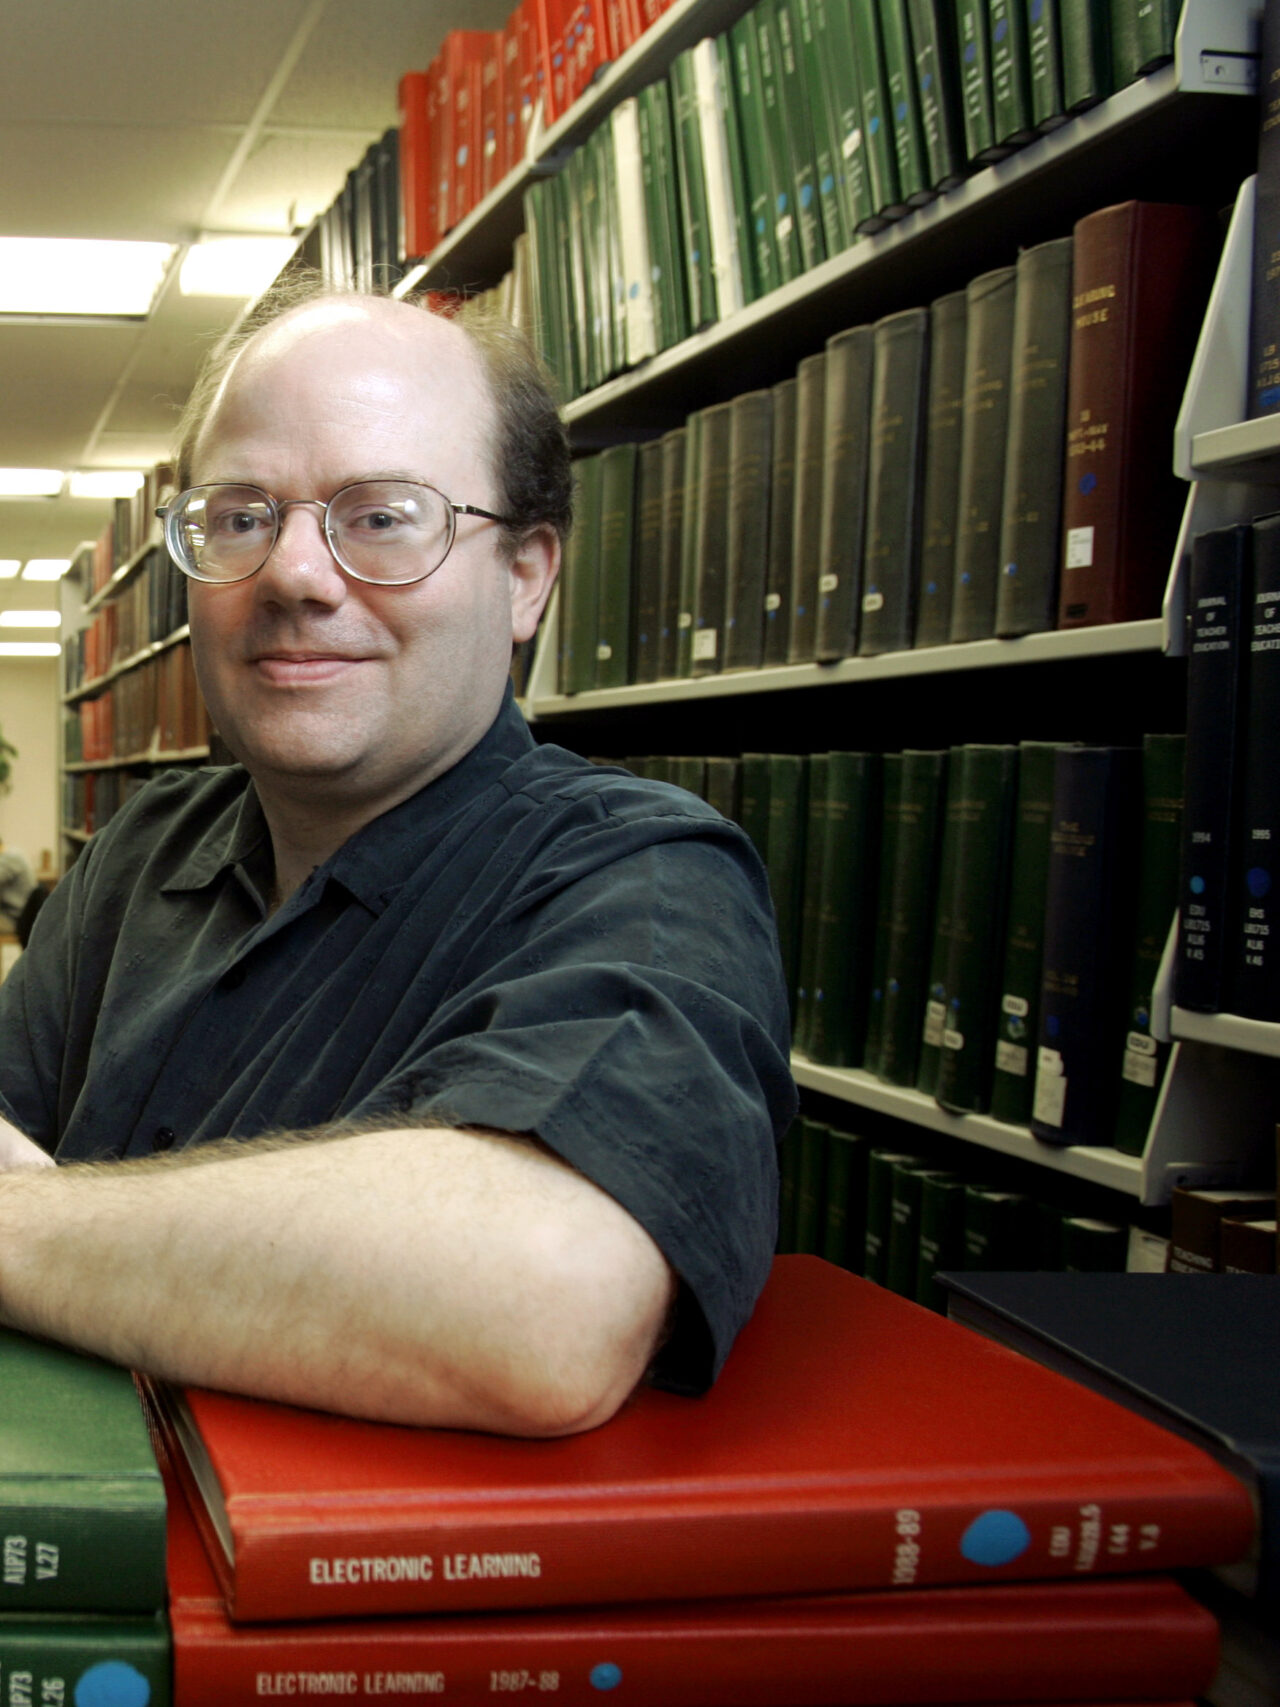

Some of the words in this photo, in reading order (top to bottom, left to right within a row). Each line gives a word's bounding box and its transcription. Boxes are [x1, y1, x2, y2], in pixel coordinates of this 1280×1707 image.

[3, 1534, 28, 1586] A1P73
[35, 1542, 60, 1581] V.27
[309, 1555, 433, 1584] ELECTRONIC
[443, 1552, 542, 1581] LEARNING
[42, 1677, 65, 1707] .26
[256, 1671, 358, 1696] ELECTRONIC
[364, 1671, 445, 1695] LEARNING
[489, 1669, 560, 1692] 1987-88
